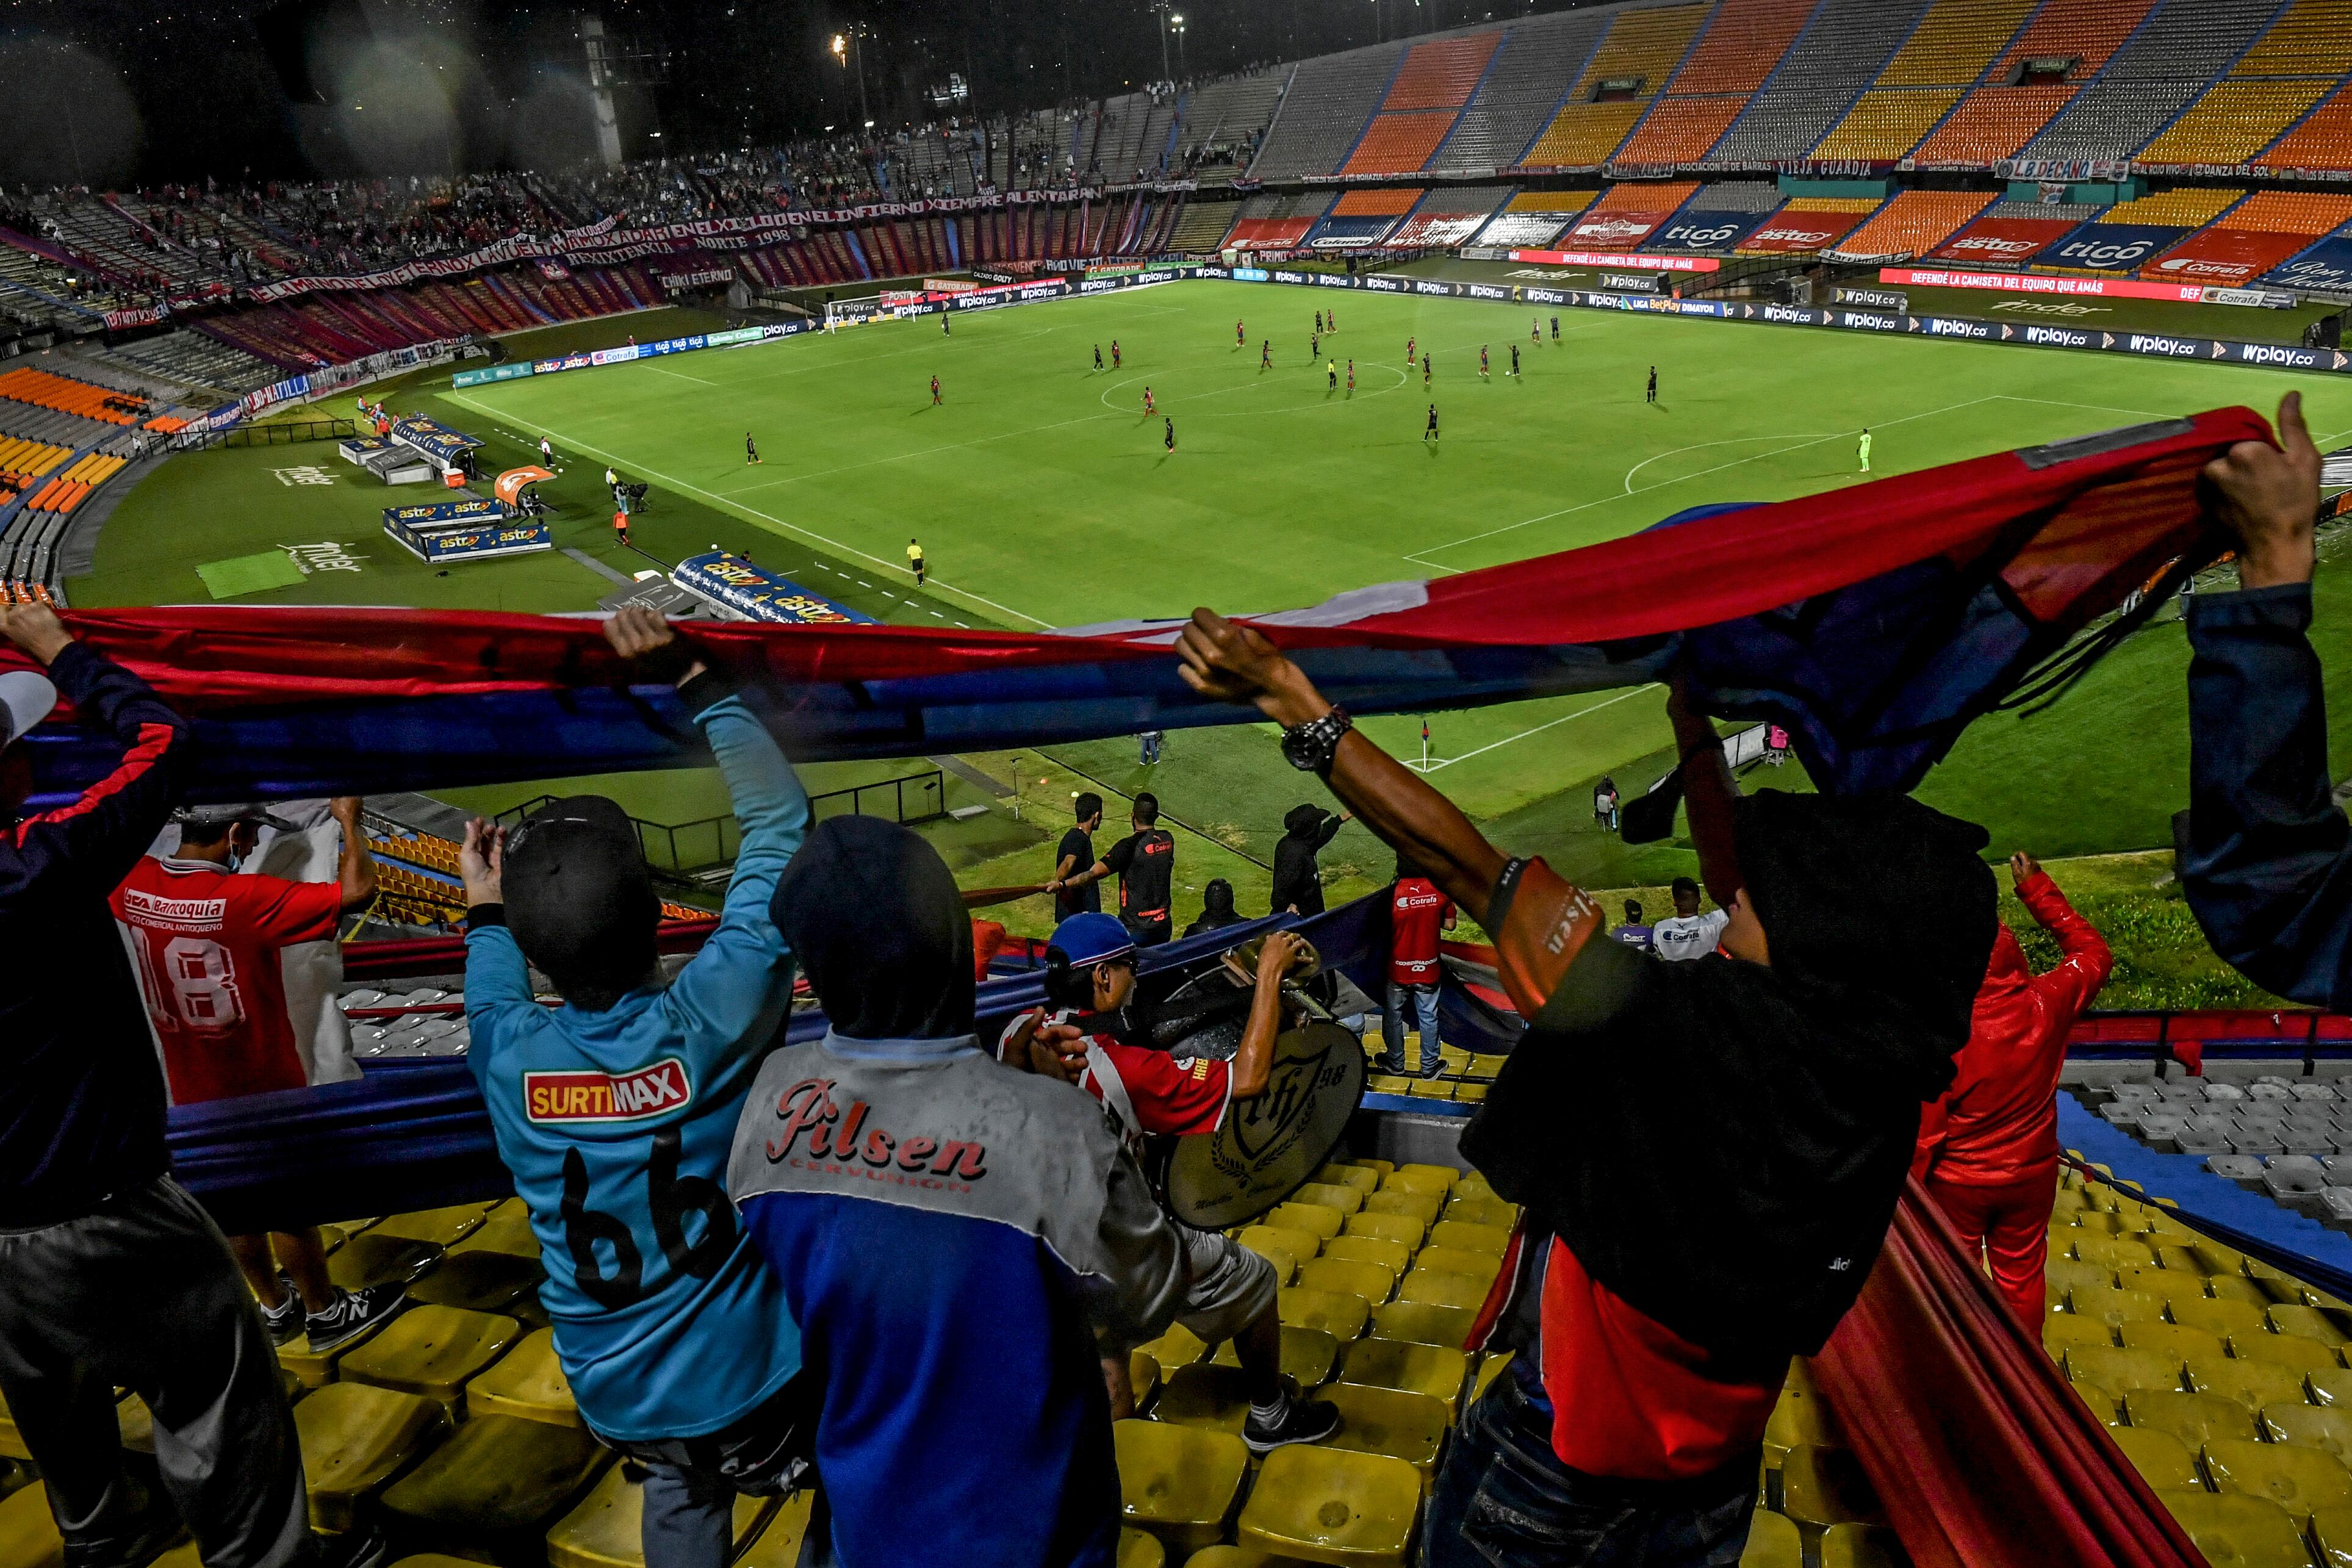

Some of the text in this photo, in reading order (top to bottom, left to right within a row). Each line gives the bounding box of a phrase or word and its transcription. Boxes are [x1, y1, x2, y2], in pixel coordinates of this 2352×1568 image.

[1731, 162, 1739, 170] DE
[1742, 161, 1771, 171] BARRAS
[1778, 160, 1871, 176] VIEJA GUARDIA
[2149, 164, 2164, 175] ROJO
[2165, 164, 2180, 176] VIVO
[2204, 165, 2268, 177] DANZA DEL SOL
[2305, 170, 2317, 181] LOS
[2318, 171, 2326, 181] DE
[1005, 185, 1102, 204] ALENTARAN
[693, 236, 748, 250] NORTE
[755, 229, 791, 246] 1998
[1755, 229, 1832, 242] astro
[1952, 237, 2040, 252] astro
[1563, 252, 1693, 270] DEFENDÉ LA CAMISETA DEL EQUIPO QUE AMÁS
[1196, 267, 1228, 278] Wplay.co
[2186, 262, 2250, 275] Cotrafa
[2282, 261, 2346, 277] Ron
[973, 271, 1012, 284] CALZADO GOLTY
[1138, 272, 1173, 284] Wplay.co
[1275, 271, 1303, 283] Wplay.co
[1320, 274, 1348, 287] Wplay.co
[1367, 278, 1397, 290] Wplay.co
[1610, 276, 1651, 290] Wplay.co
[1911, 272, 2104, 293] DEFENDÉ LA CAMISETA DEL EQUIPO QUE AMÁS
[1081, 279, 1116, 291] Wplay.co
[1417, 281, 1449, 295] Wplay.co
[1470, 285, 1504, 299] Wplay.co
[1021, 287, 1057, 300] Wplay.co
[1527, 289, 1564, 303] Wplay.co
[1846, 290, 1896, 306] Wplay.co
[2180, 287, 2201, 299] DEF
[2219, 293, 2257, 304] Cotrafa
[959, 295, 997, 309] Wplay.co
[1633, 298, 1714, 314] LIGA BetPlay DIMAYOR
[1764, 306, 1812, 323] Wplay.co
[1844, 313, 1896, 329] Wplay.co
[1932, 318, 1988, 337] Wplay.co
[709, 330, 761, 344] Colanta Colanta
[2027, 326, 2087, 347] Wplay.co
[2130, 335, 2196, 356] Wplay.co
[564, 355, 591, 369] astro
[606, 351, 636, 362] Cotrafa
[2243, 344, 2315, 366] Wplay.co
[534, 360, 561, 373] astro
[399, 507, 437, 519] astro
[455, 500, 491, 514] astro
[439, 535, 480, 549] astro
[500, 528, 539, 543] astro
[702, 560, 771, 587] astro
[774, 594, 852, 624] astro
[1409, 896, 1437, 906] Cotrafa
[153, 899, 223, 919] Bancoquia
[141, 916, 223, 932] COMERCIAL ANTIOQUEÑO
[129, 925, 246, 1038] 18
[532, 1066, 682, 1117] SURTIMAX
[765, 1077, 988, 1181] Pilsen
